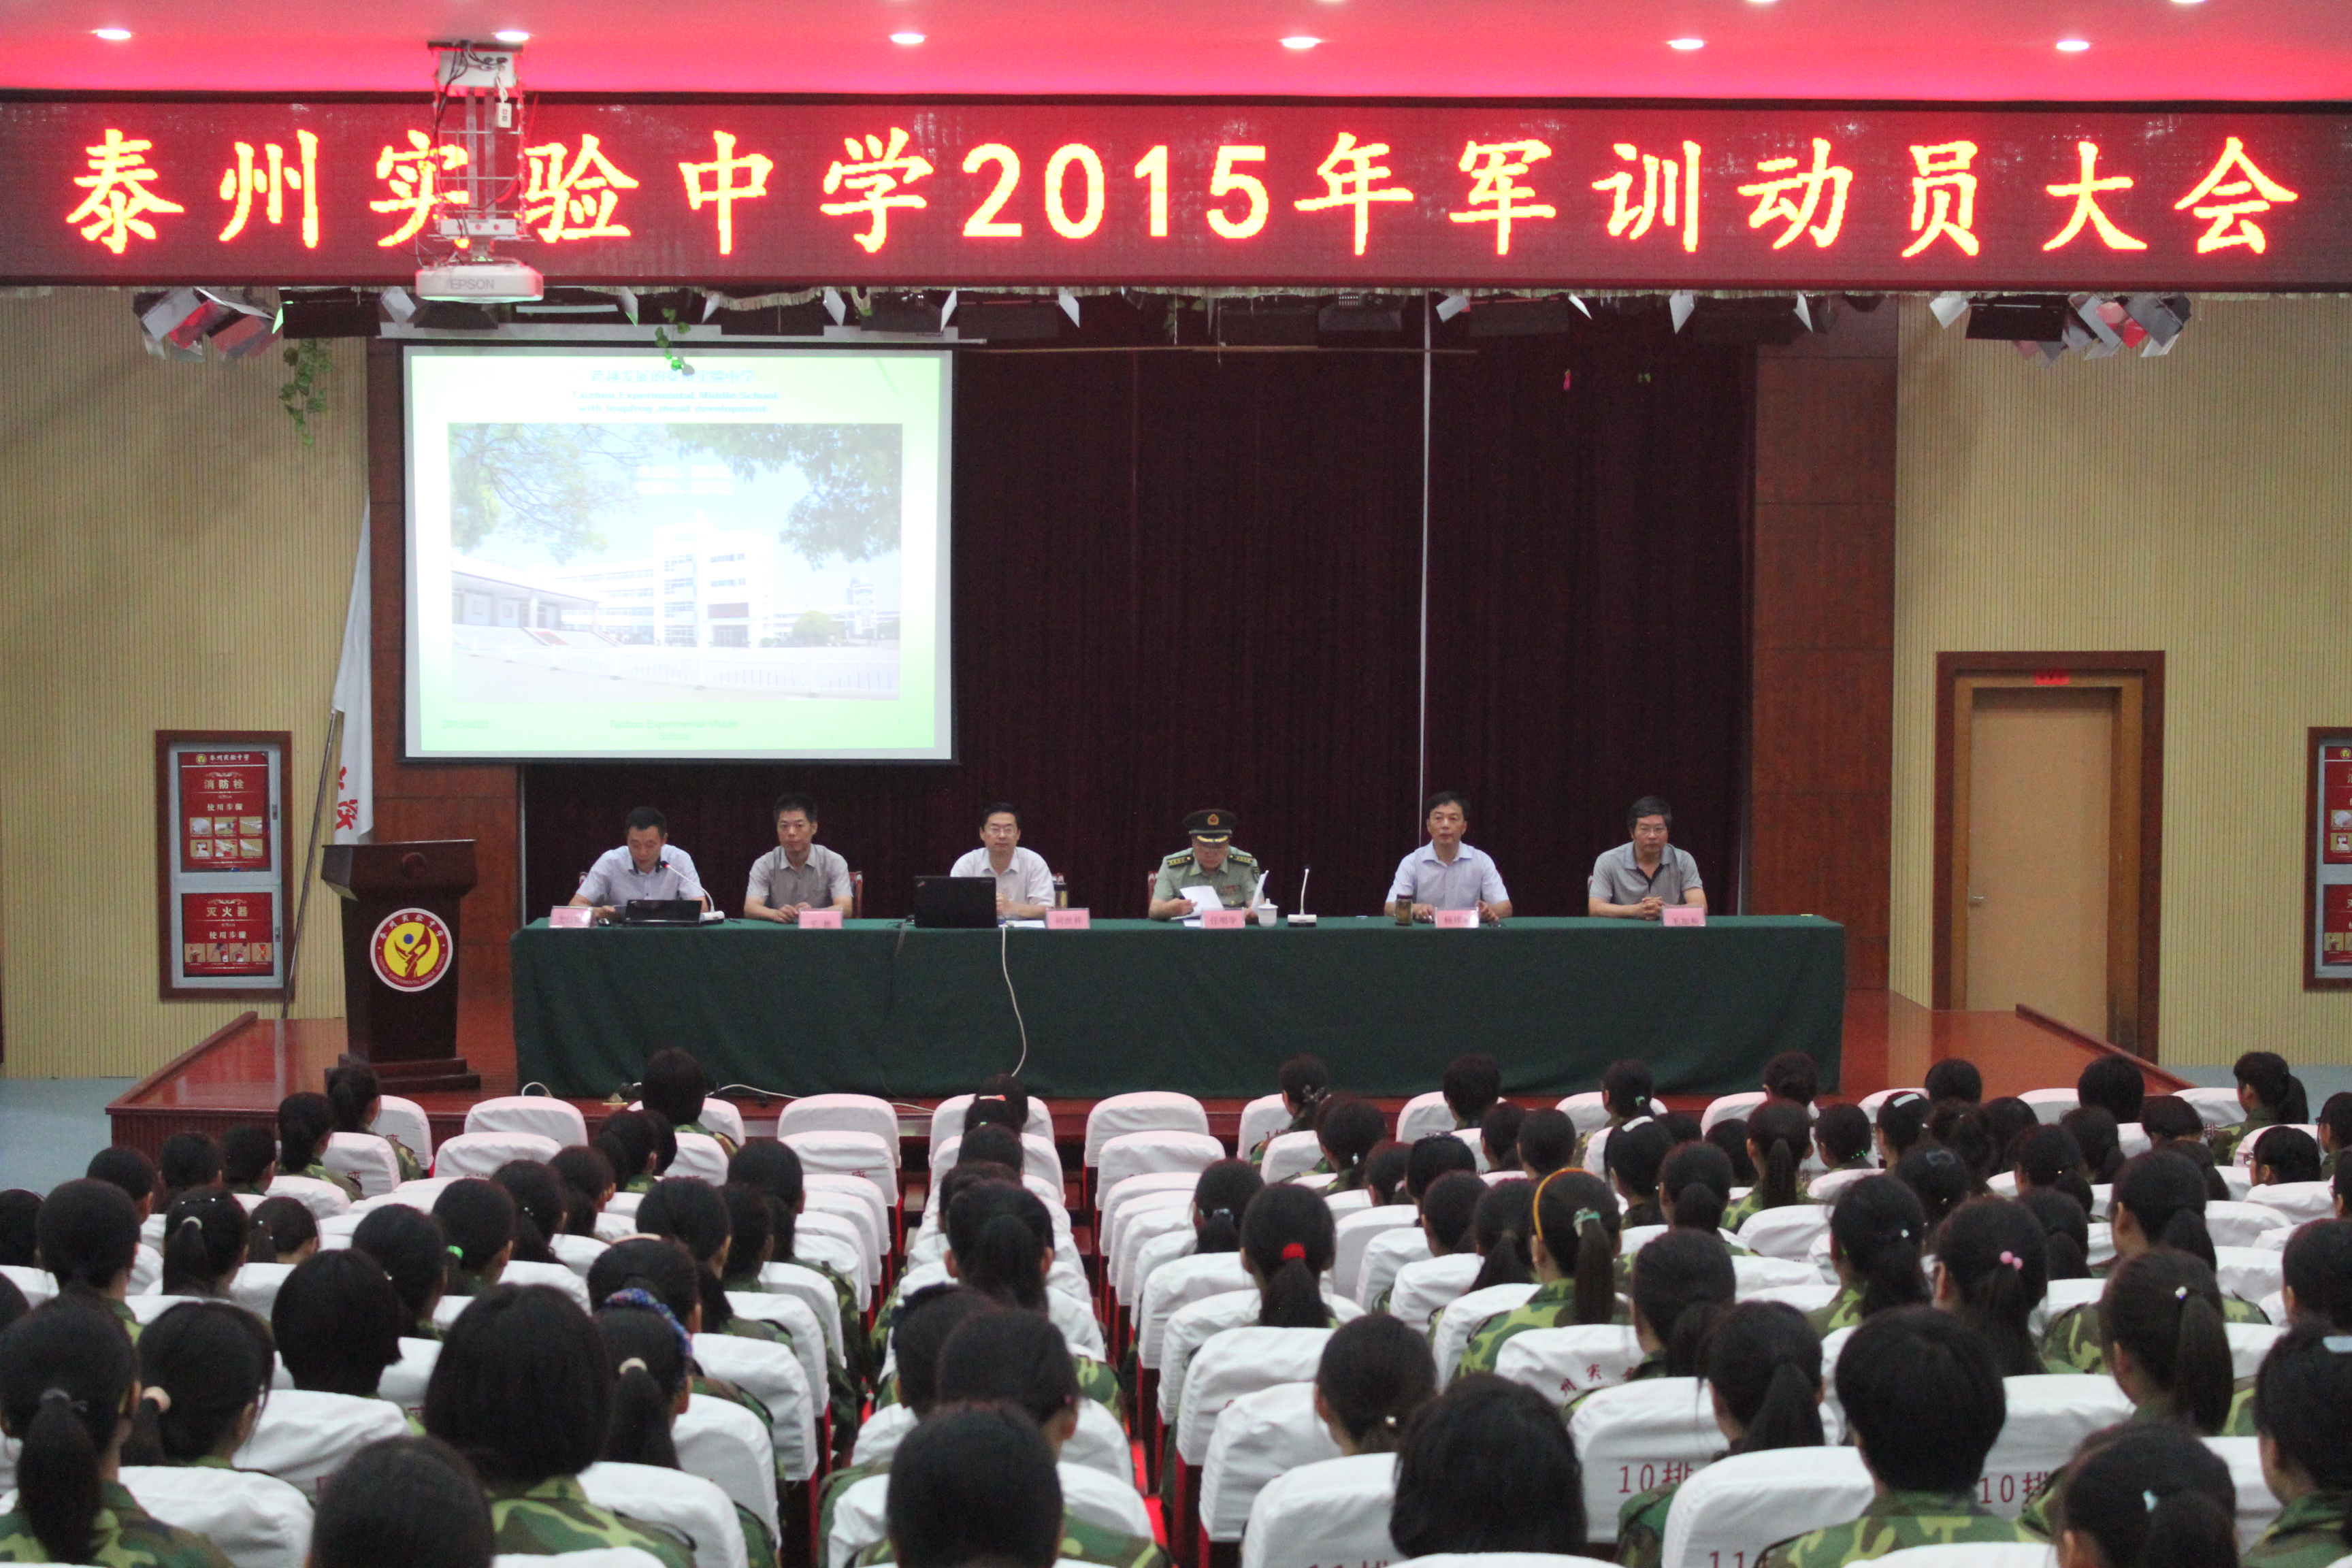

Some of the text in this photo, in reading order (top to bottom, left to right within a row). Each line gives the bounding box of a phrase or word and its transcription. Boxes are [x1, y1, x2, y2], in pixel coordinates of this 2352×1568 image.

[66, 127, 2298, 257] 泰州实验中学2015年军训动员大会
[451, 279, 495, 289] EPSON
[572, 391, 778, 402] Taizhou Experimental Middle School
[606, 405, 653, 414] leapfrog
[694, 405, 768, 414] development
[204, 779, 244, 789] 消防栓
[206, 906, 248, 917] 灭火器
